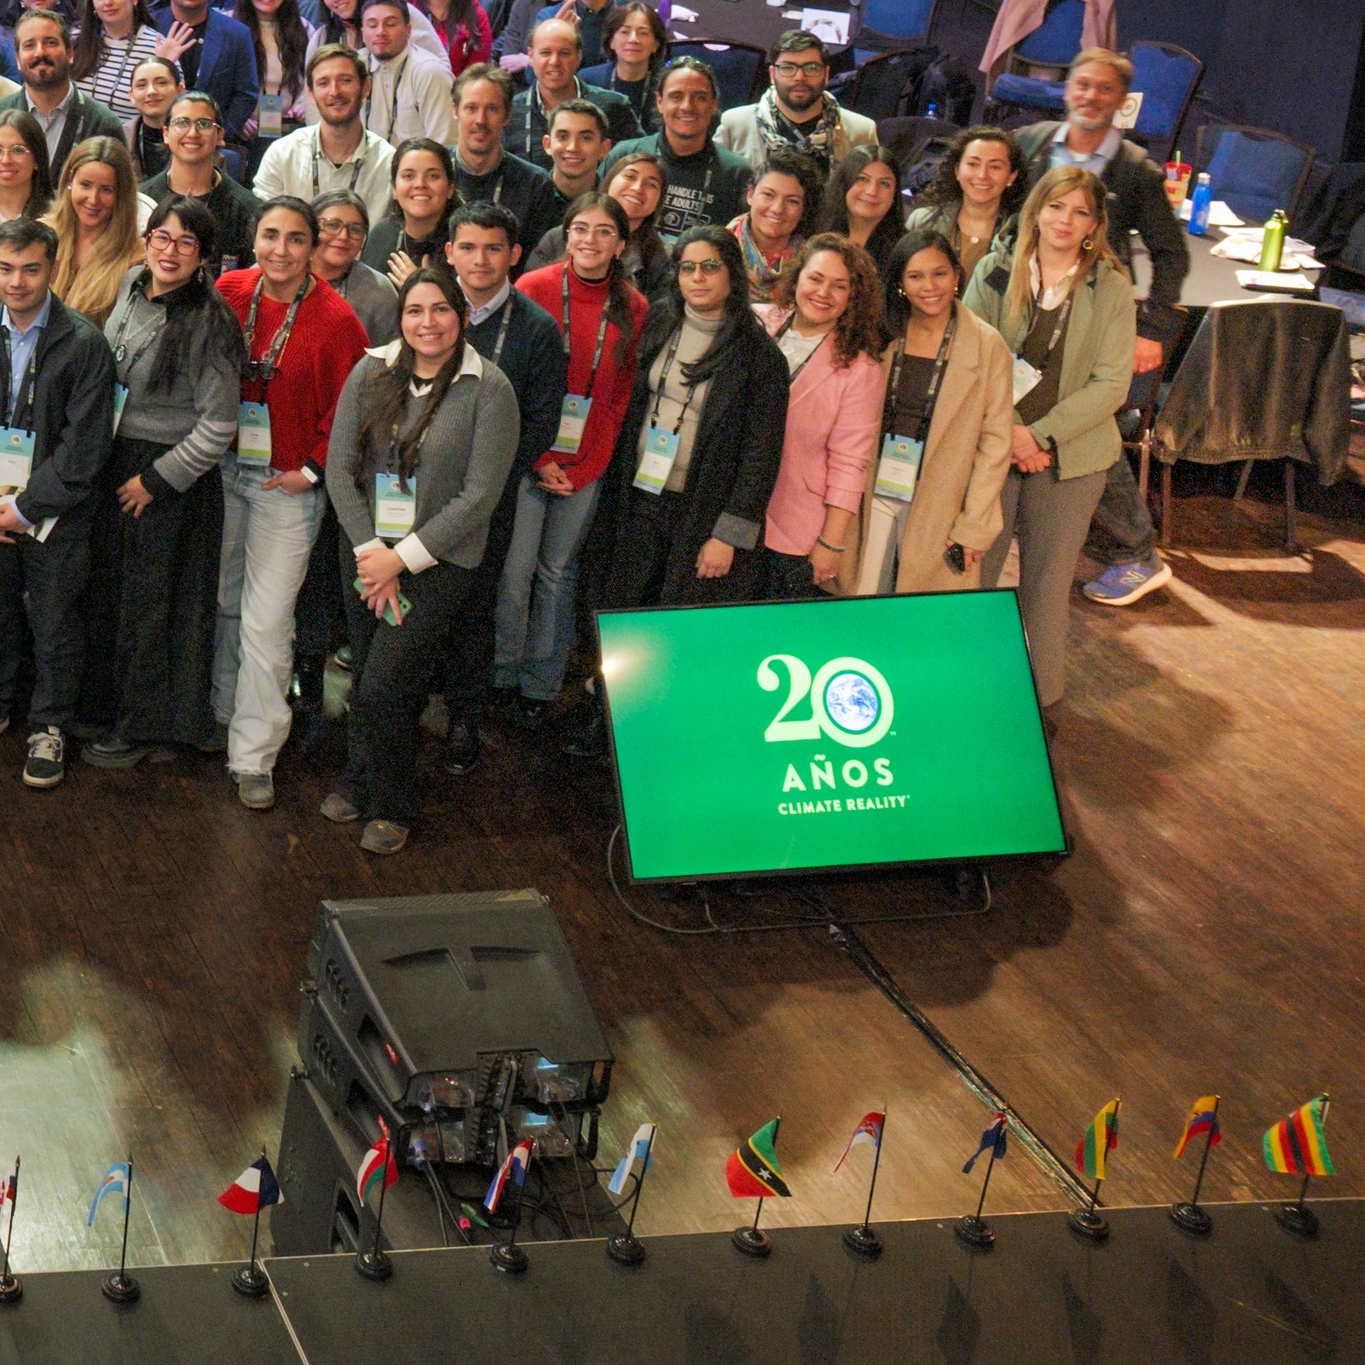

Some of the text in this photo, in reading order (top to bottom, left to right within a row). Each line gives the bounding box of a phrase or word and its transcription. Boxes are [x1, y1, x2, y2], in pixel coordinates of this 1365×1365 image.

[667, 184, 697, 200] HANDLE
[671, 196, 701, 211] ADULTS
[756, 654, 894, 748] 20
[782, 754, 894, 792] AÑOS
[778, 800, 842, 816] CLIMATE
